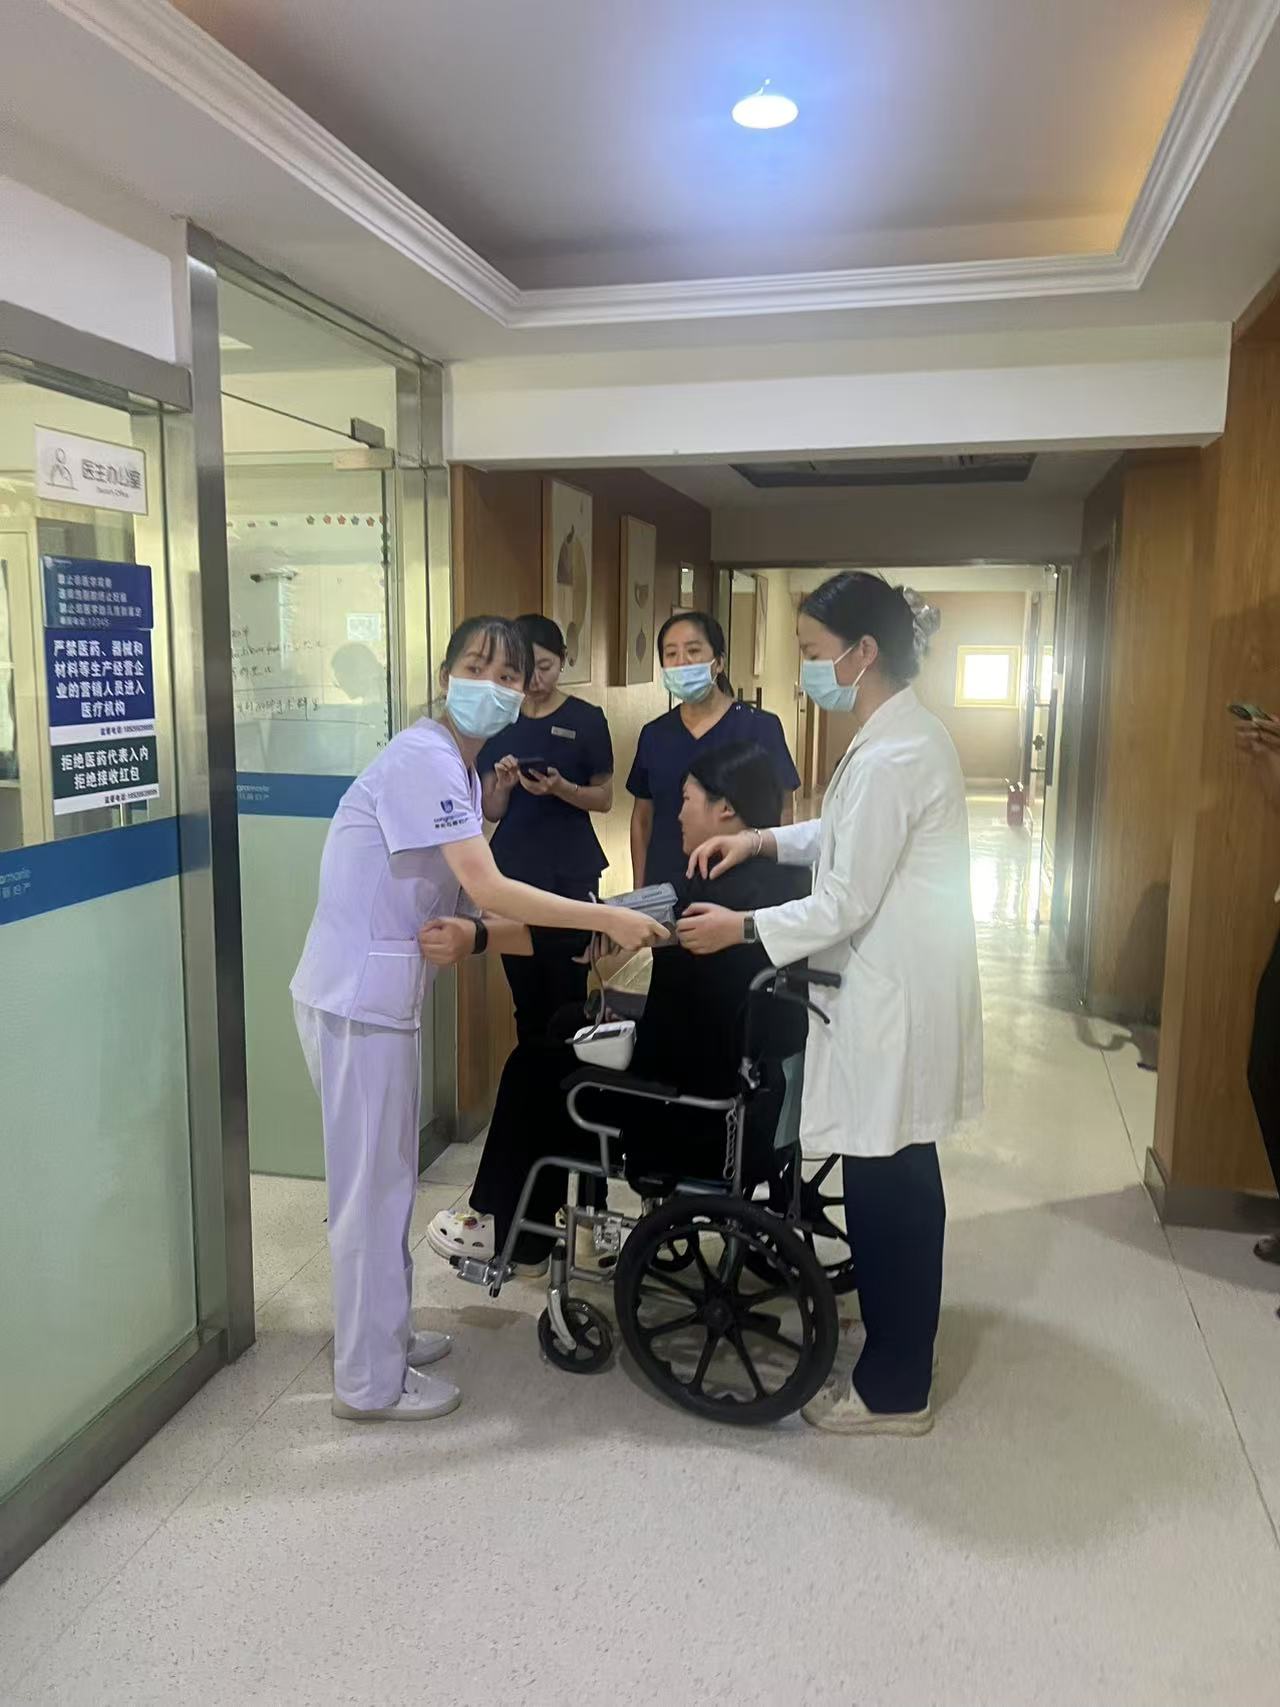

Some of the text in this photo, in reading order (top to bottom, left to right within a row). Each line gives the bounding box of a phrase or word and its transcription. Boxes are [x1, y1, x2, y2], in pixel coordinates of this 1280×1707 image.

[53, 639, 144, 657] 严禁医药、器械和
[53, 660, 145, 679] 材料等生产经营企
[55, 680, 146, 699] 业的营销人员进入
[80, 700, 126, 718] 医疗机构
[60, 745, 149, 772] 拒绝医药代表入内
[73, 766, 140, 791] 拒绝接收红包
